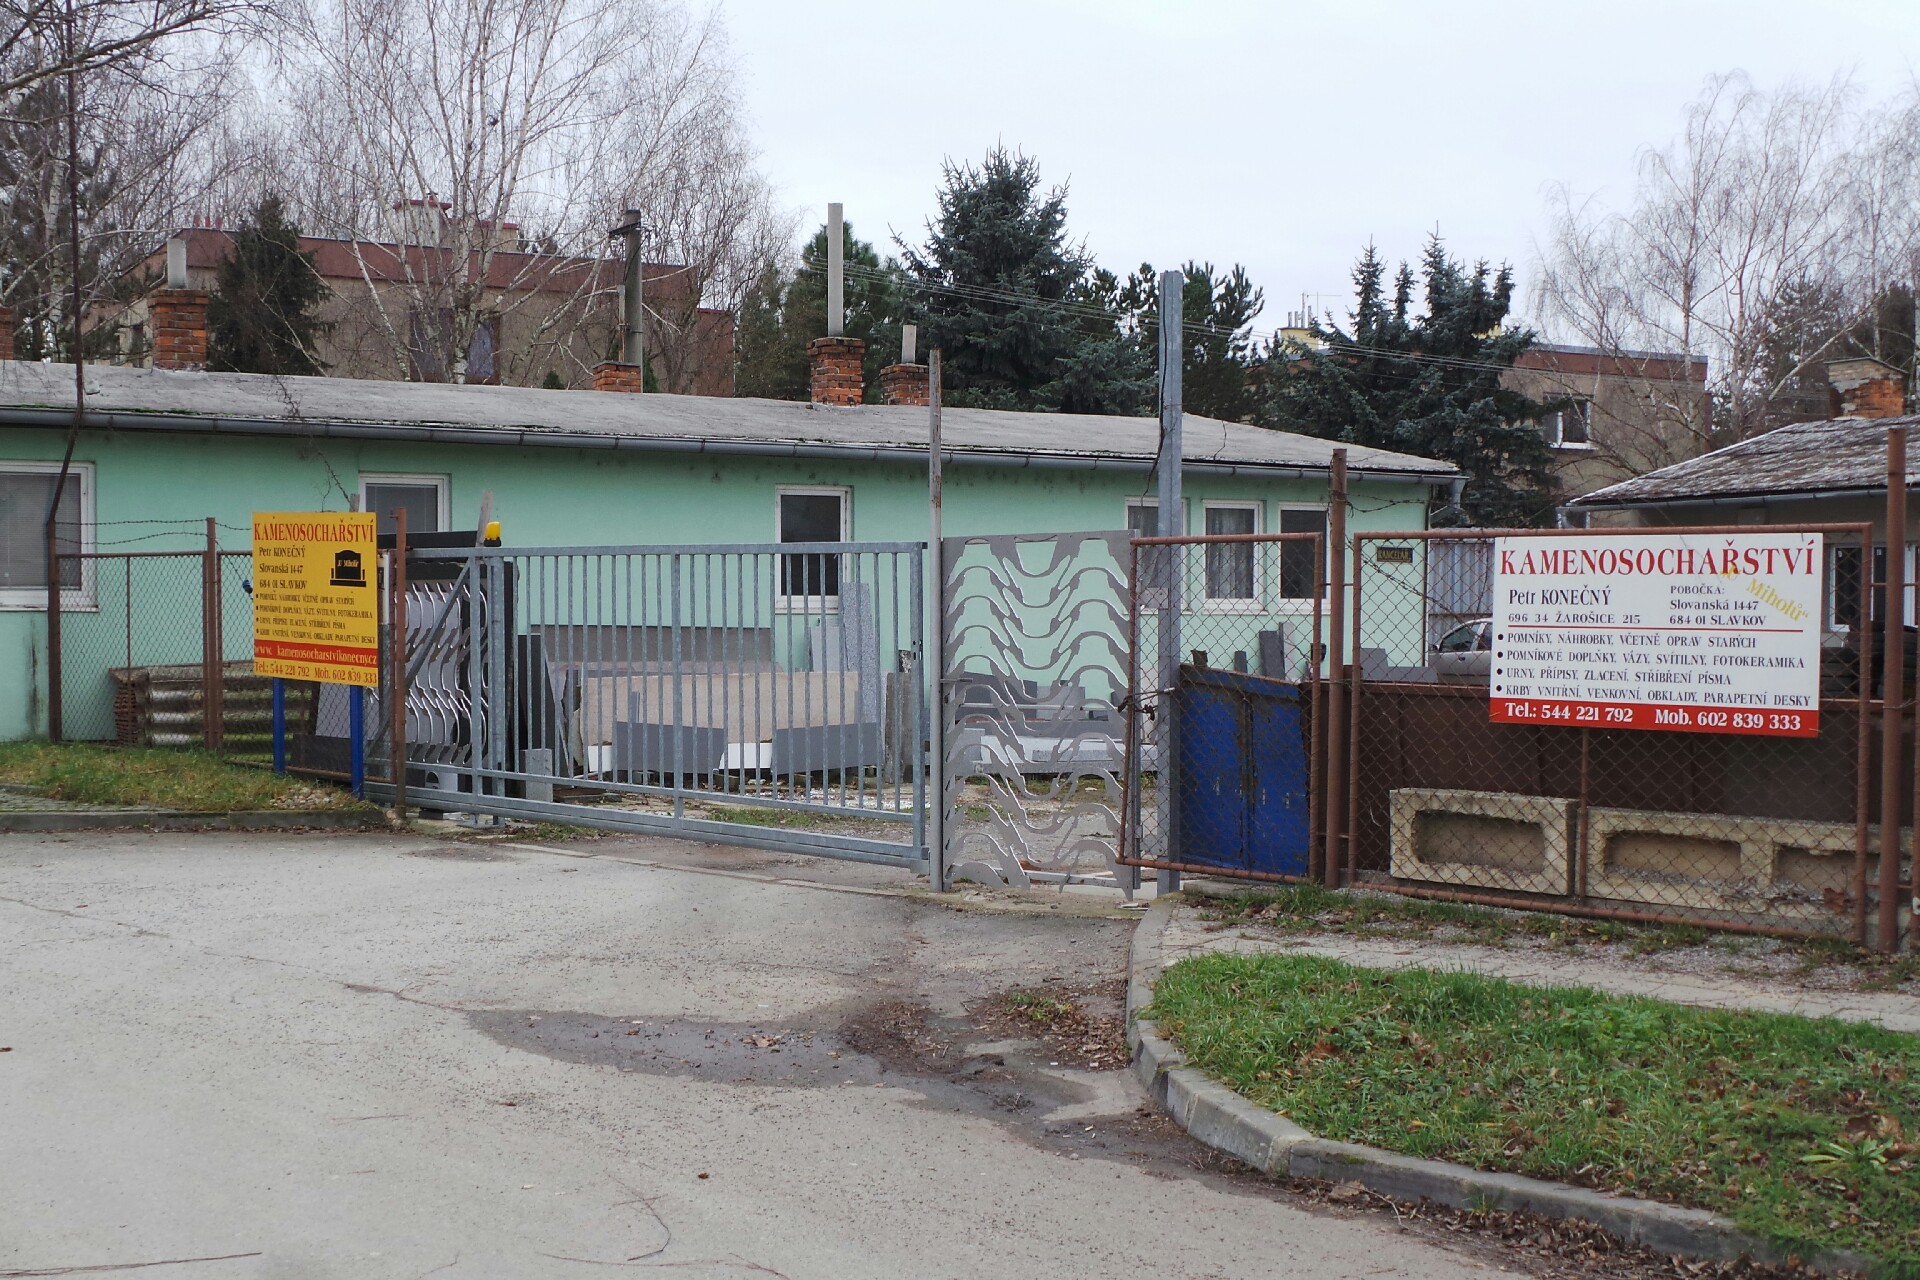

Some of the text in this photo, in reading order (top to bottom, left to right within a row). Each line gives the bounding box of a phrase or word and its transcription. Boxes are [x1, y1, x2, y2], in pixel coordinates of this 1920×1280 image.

[254, 518, 374, 543] KAMENOSOCHAŘSTVÍ
[259, 545, 306, 557] Petr KONEČNÝ
[1500, 539, 1815, 575] KAMENOSOCHAŘSTVÍ
[259, 563, 289, 574] Slovanská
[259, 579, 271, 588] 684
[1670, 583, 1725, 595] POBOČKA:
[1509, 584, 1612, 606] Petr KONEČNÝ
[1670, 599, 1759, 611] Slovanská 1447
[1508, 611, 1640, 624] 696 34 ŽAROŠICE 215
[1669, 615, 1691, 625] 684
[1710, 615, 1767, 626] SLAVKOV
[1507, 630, 1756, 648] POMNÍKY, NÁHROBKY, VČETNĚ OPRAV STARÝCH
[1507, 648, 1805, 668] POMNÍKOVÉ DOPLŇKY, VÁZY, SVÍTILNY, FOTOKERAMIKA
[270, 663, 283, 674] 544
[285, 665, 296, 675] 221
[297, 666, 310, 677] 792
[332, 670, 346, 680] 602
[347, 671, 361, 682] 839
[363, 672, 377, 683] 333
[1507, 666, 1732, 685] URNY, PŘÍPISY, ZLACENÍ, STŘÍBŘENÍ PÍSMA
[1506, 684, 1811, 707] KRBY VNITŘNÍ, VENKOVNÍ, OBKLADY, PARAPETNÍ DESKY
[1505, 702, 1801, 730] Tel.: 544 221 792 Mob. 602 839 333
